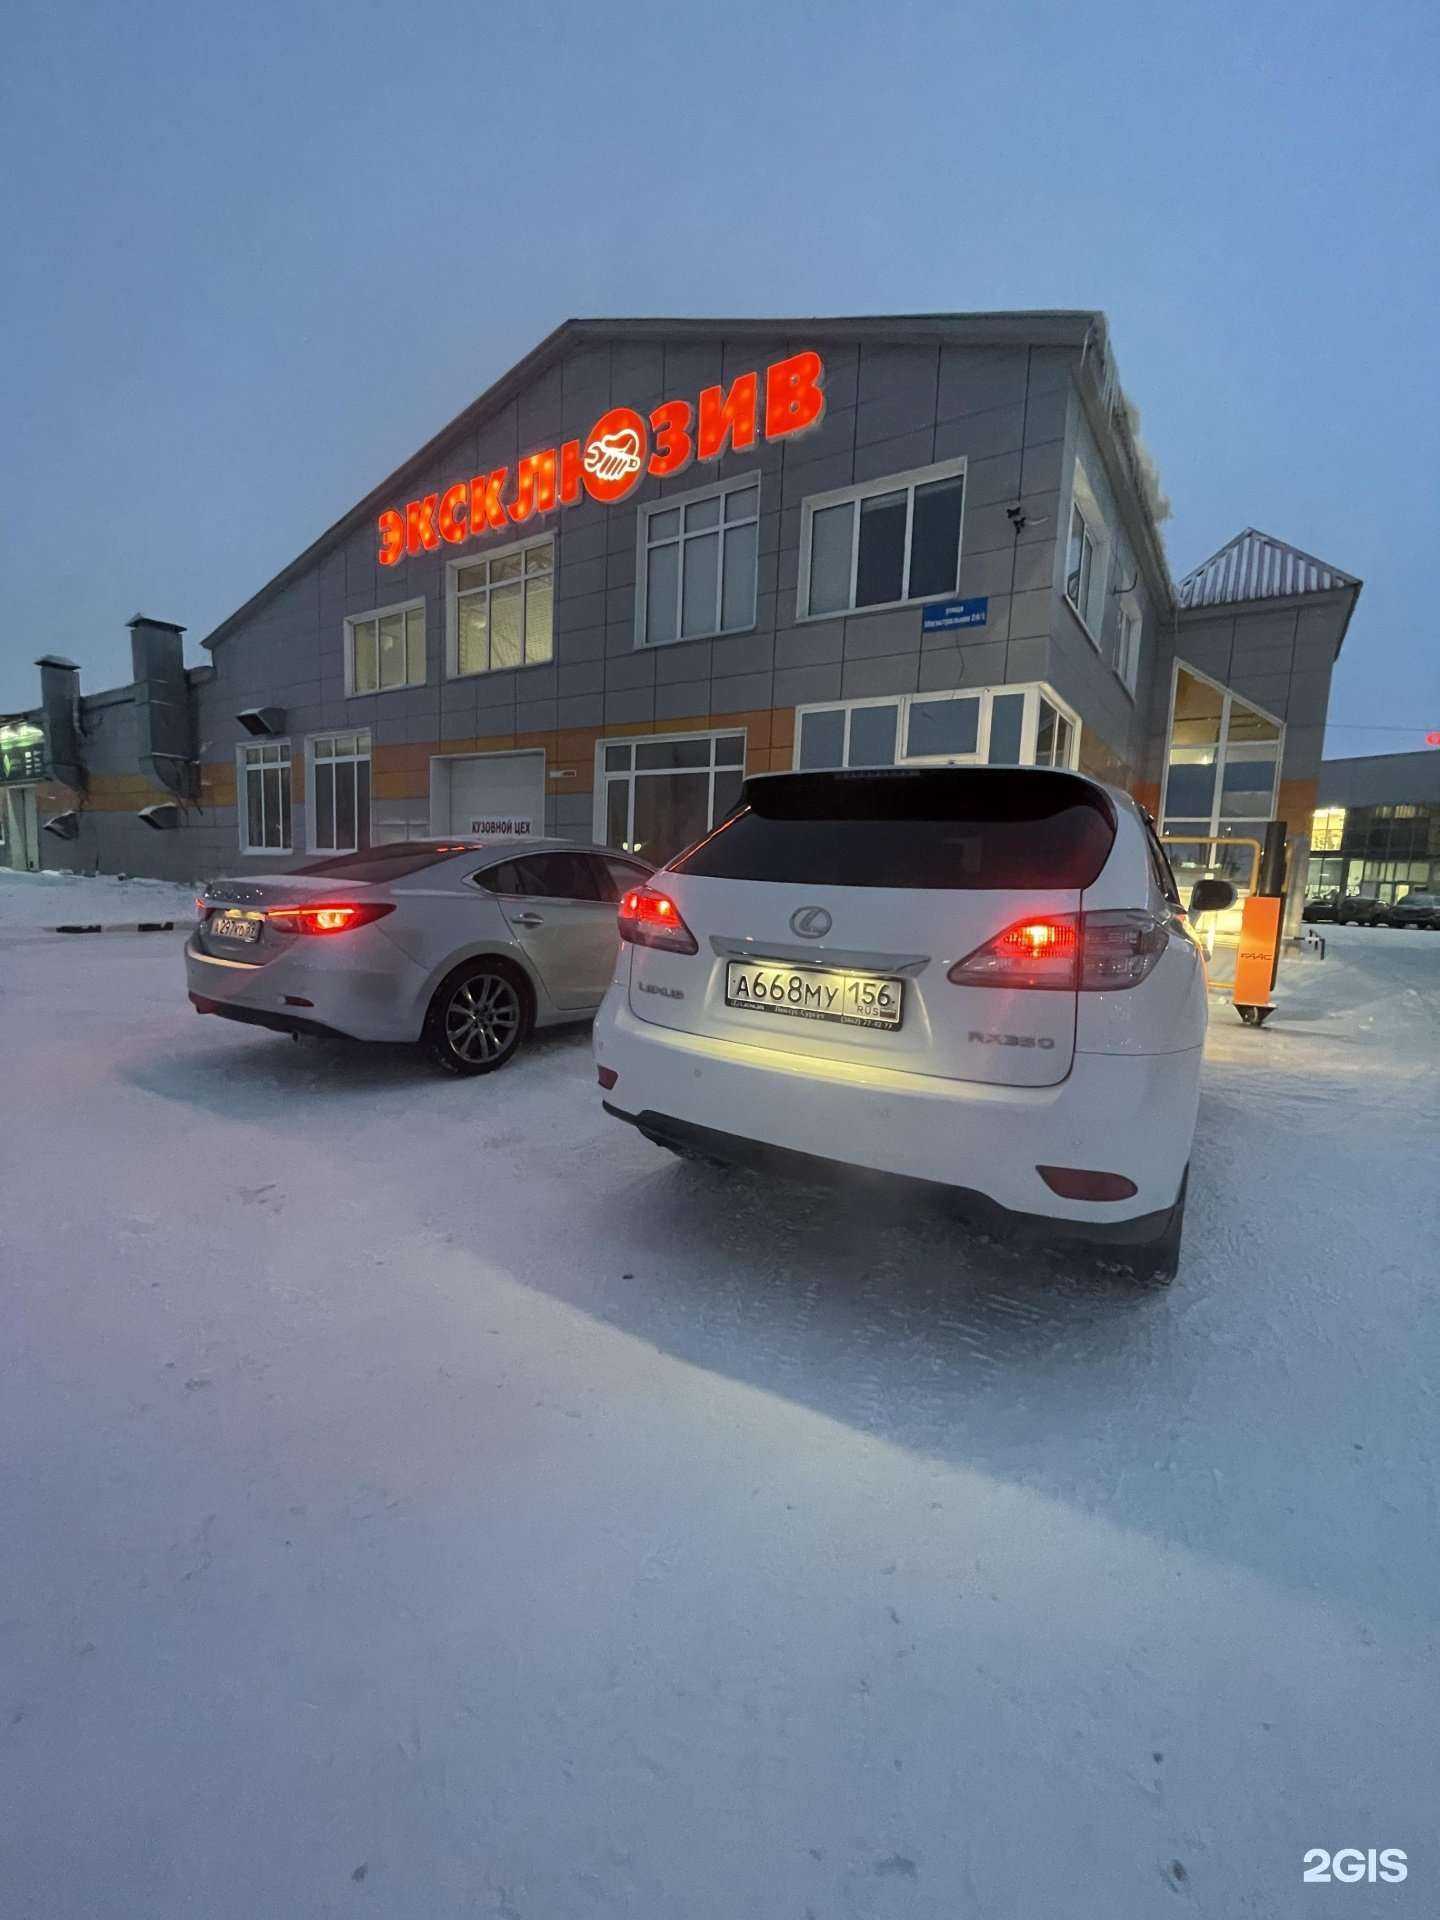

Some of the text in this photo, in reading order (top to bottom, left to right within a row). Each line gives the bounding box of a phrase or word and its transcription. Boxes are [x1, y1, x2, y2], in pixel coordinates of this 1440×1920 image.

[378, 351, 826, 567] ЭКСКЛЮЗИВ
[472, 819, 530, 835] КУЗОВНОЙ ЦЕХ
[638, 980, 685, 1000] LEXUS
[848, 982, 891, 1007] 156
[857, 1005, 880, 1016] RUS
[967, 1031, 1055, 1050] RX350
